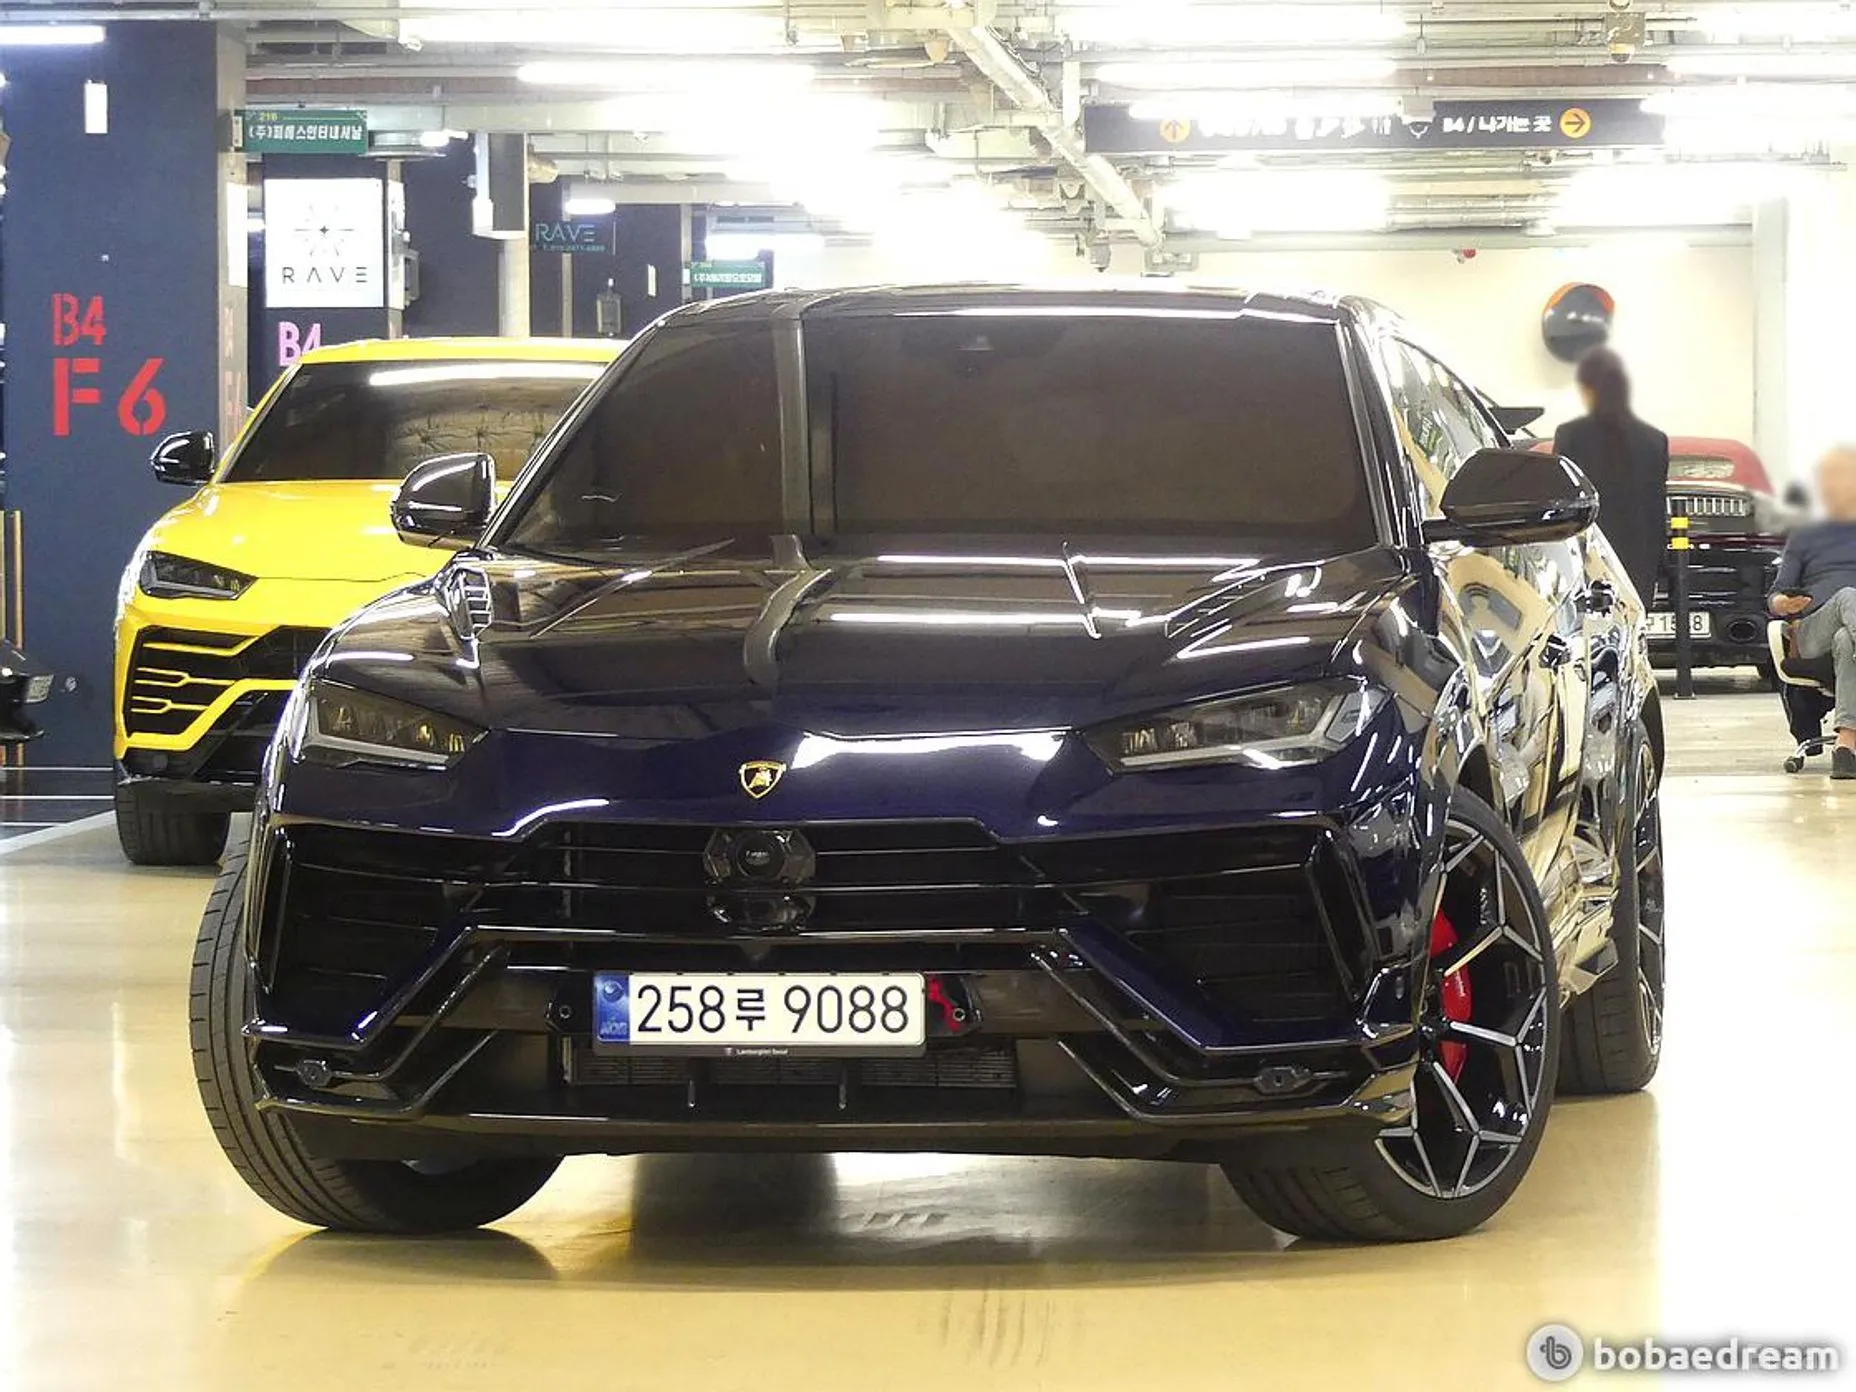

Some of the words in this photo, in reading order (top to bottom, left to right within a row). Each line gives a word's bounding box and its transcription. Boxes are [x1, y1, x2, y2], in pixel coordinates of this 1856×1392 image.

[535, 222, 596, 242] RAVE
[281, 266, 368, 284] RAVE
[52, 292, 106, 347] B4
[277, 321, 323, 367] B4
[52, 357, 102, 437] F
[117, 357, 168, 437] 6
[636, 984, 767, 1034] 258루
[784, 984, 910, 1034] 9088
